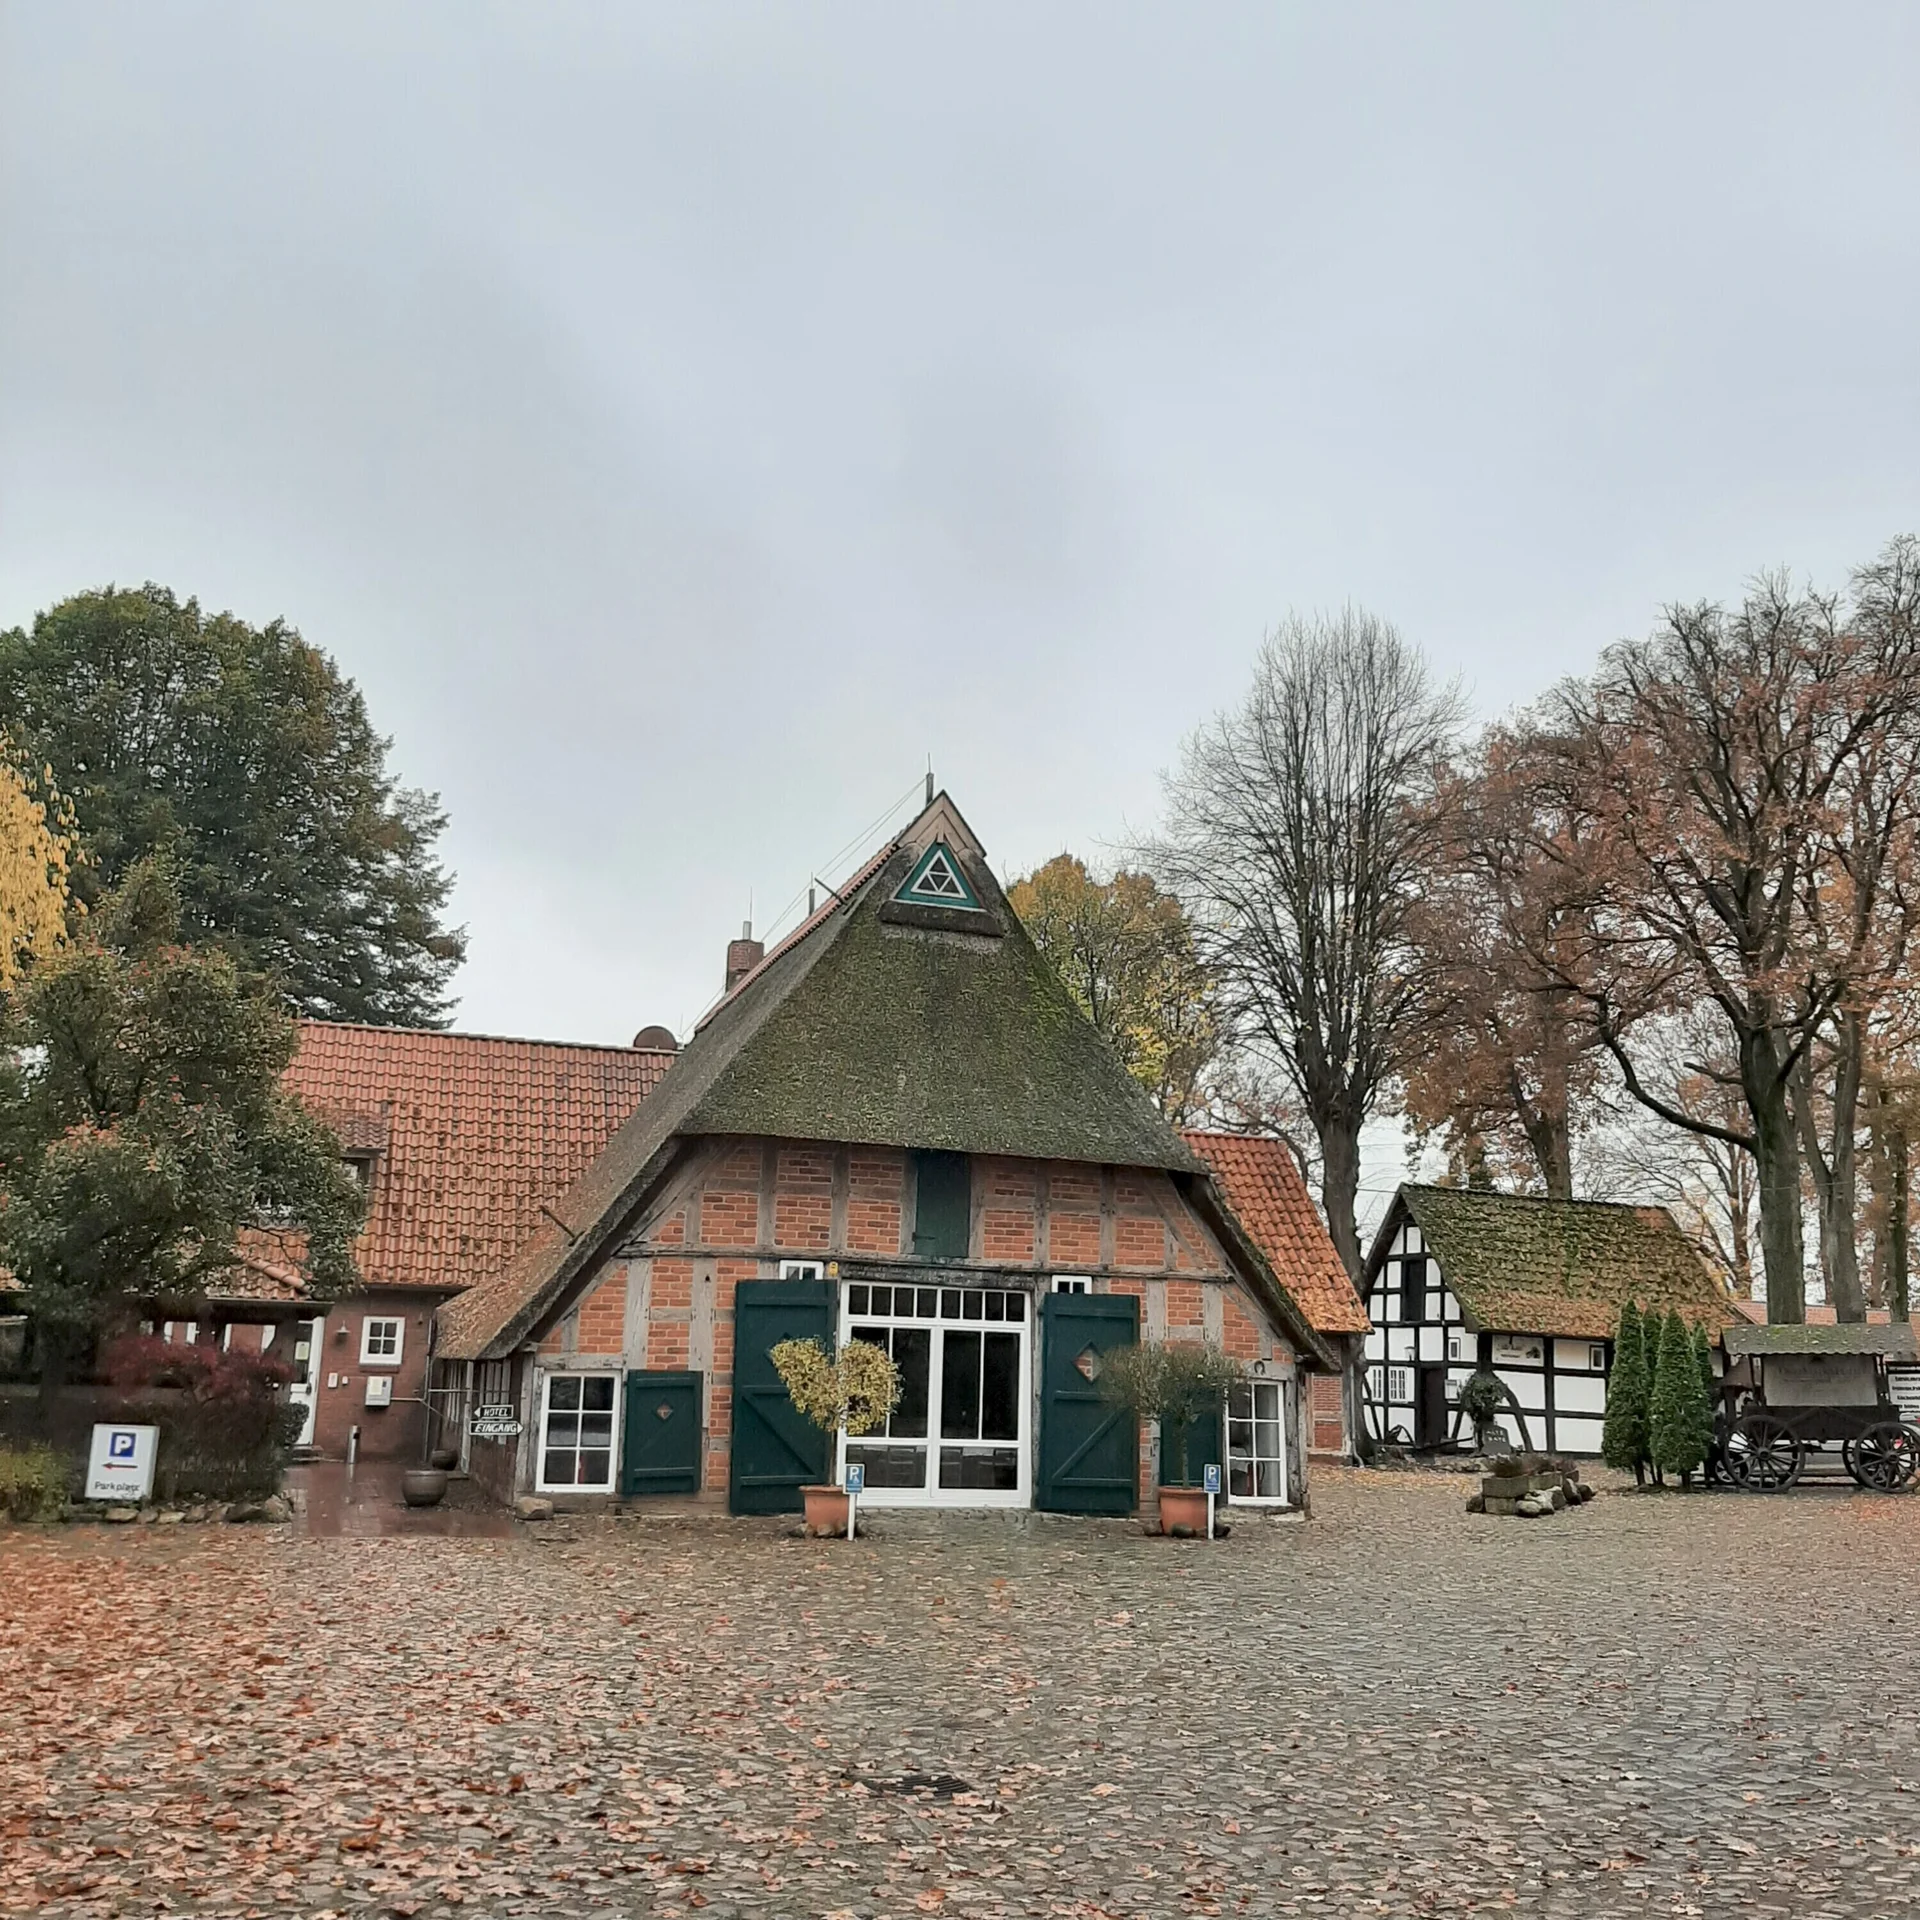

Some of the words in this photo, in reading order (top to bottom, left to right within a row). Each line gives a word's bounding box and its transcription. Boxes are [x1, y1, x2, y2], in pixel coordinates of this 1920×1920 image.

[483, 1407, 509, 1417] HOTEL
[474, 1423, 517, 1433] EINGANG
[114, 1435, 132, 1454] P
[1208, 1466, 1217, 1480] P
[94, 1481, 140, 1492] Parkplatz
